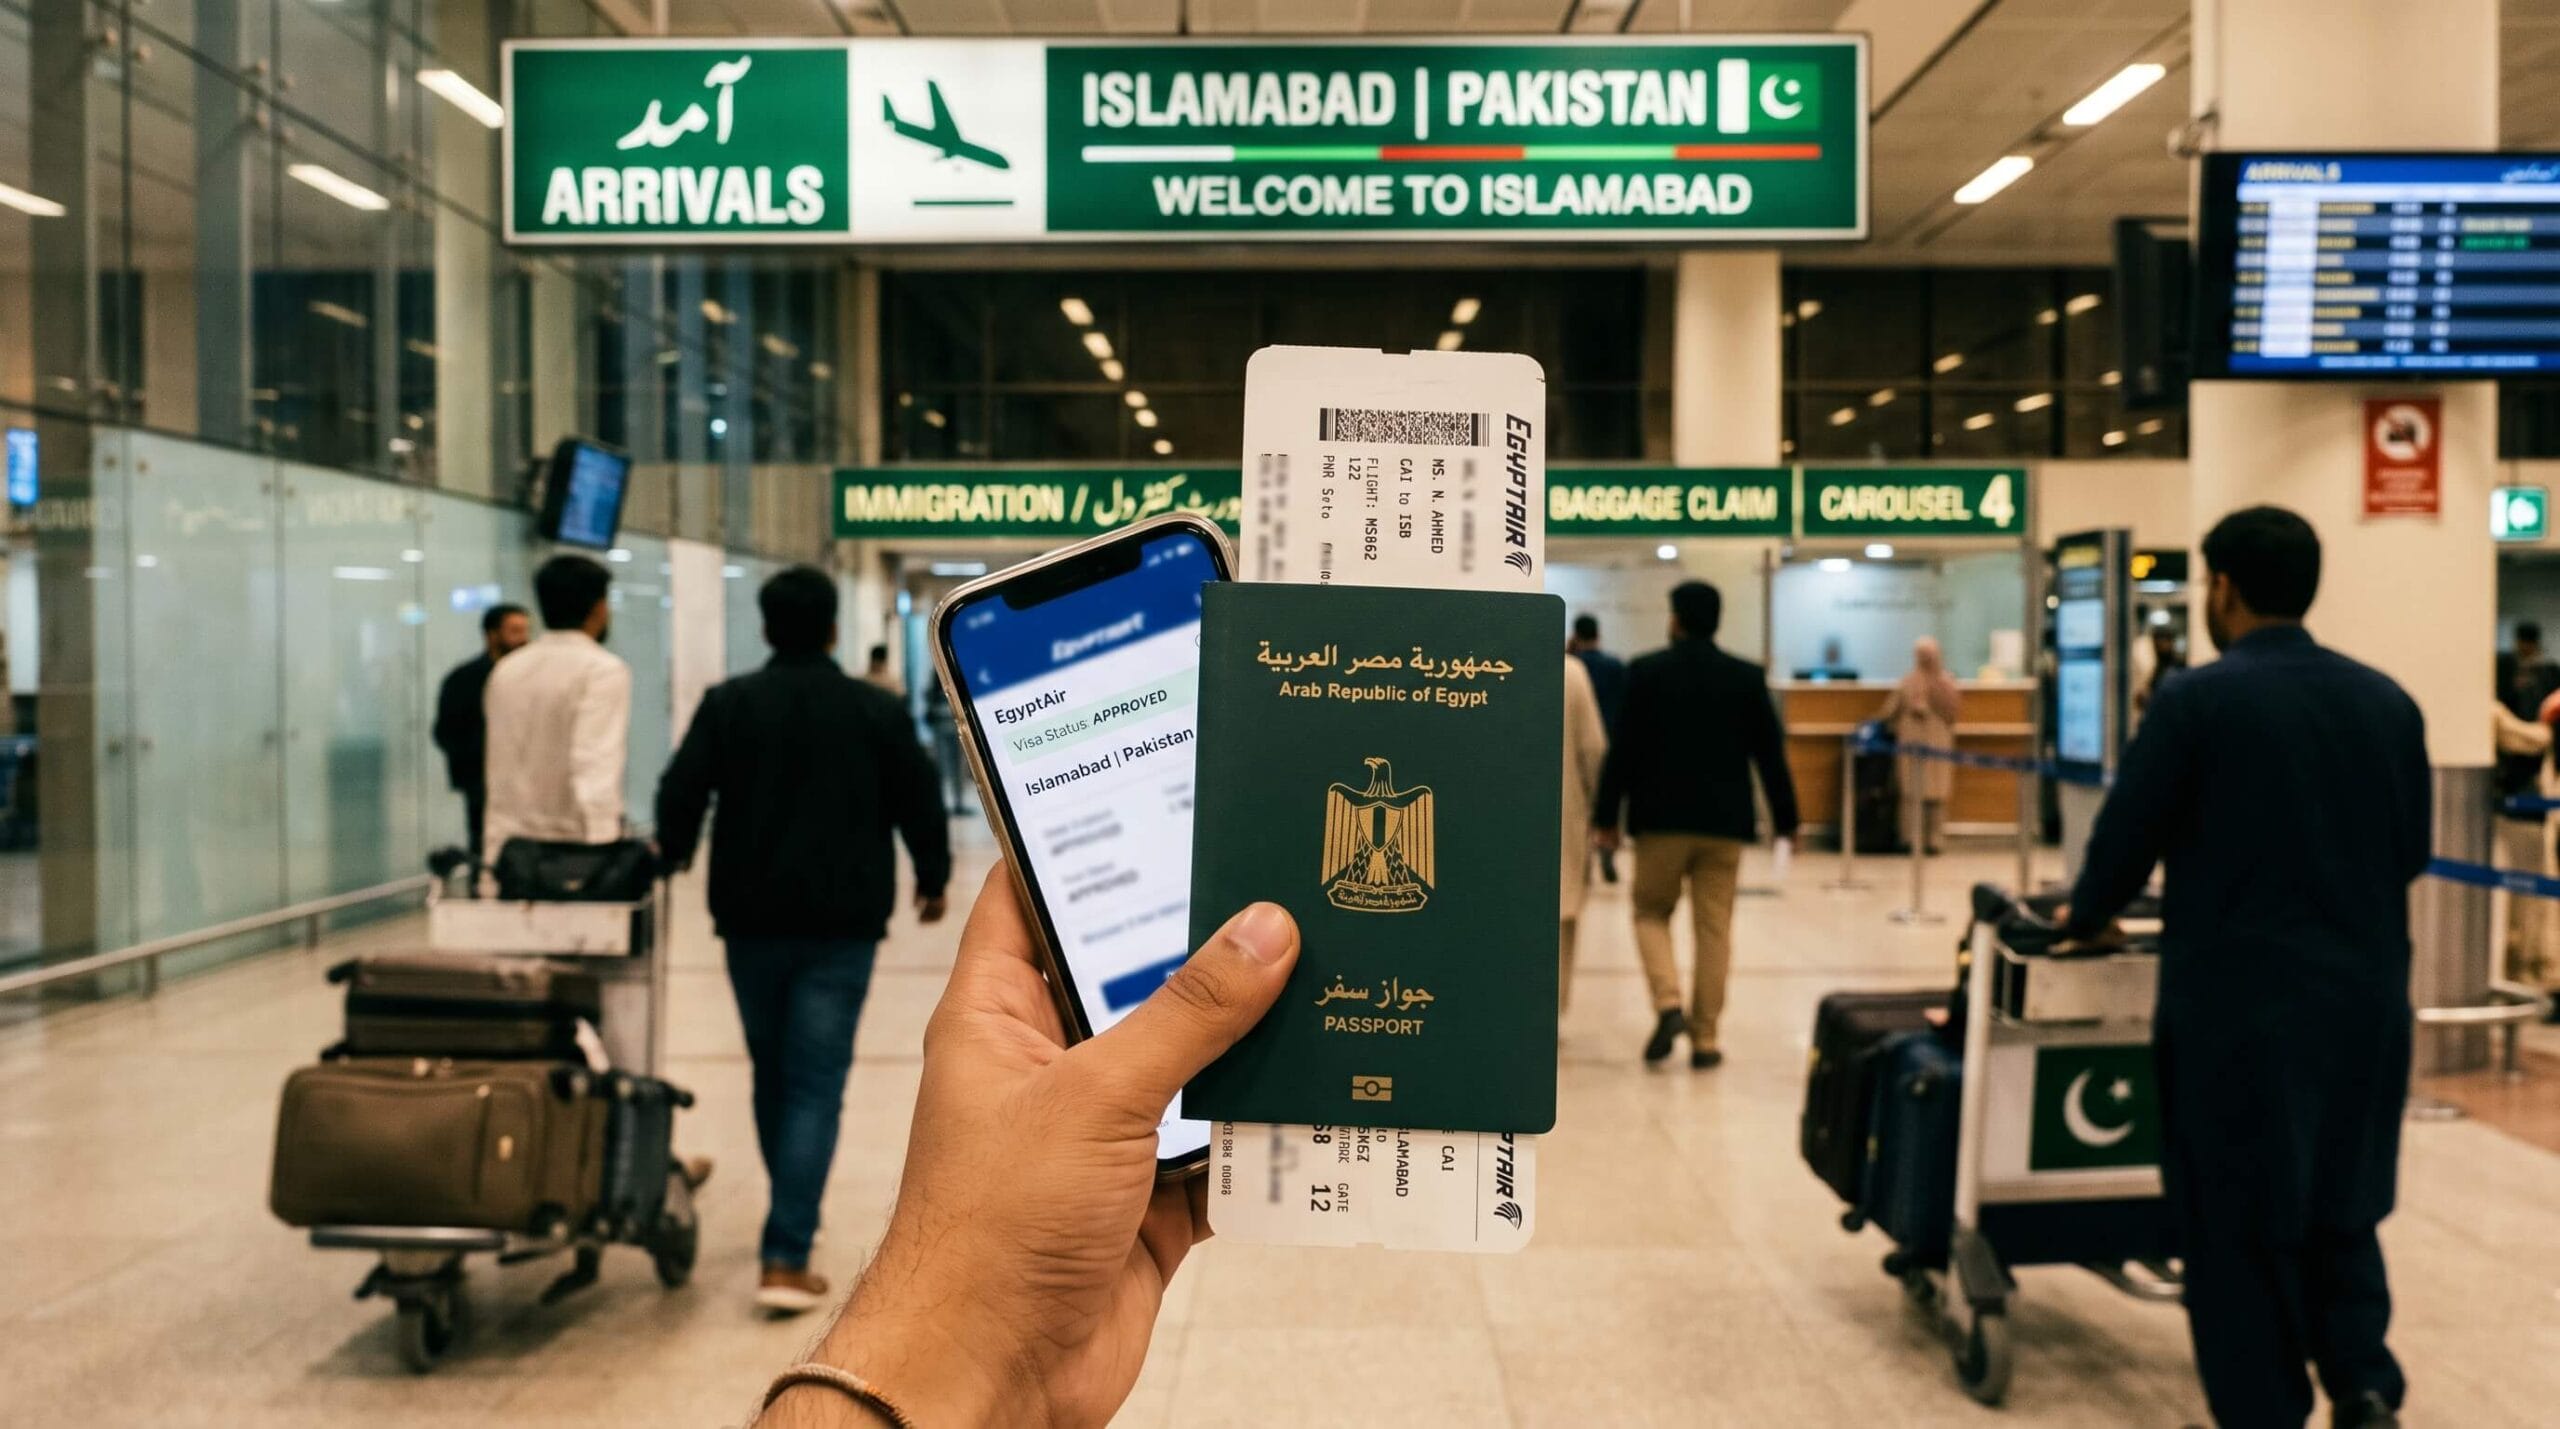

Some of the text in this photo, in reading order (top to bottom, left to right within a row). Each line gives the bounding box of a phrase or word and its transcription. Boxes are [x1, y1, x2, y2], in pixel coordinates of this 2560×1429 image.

[616, 55, 752, 151] آمد
[1083, 70, 1397, 127] ISLAMABAD
[1447, 71, 1707, 127] PAKISTAN
[542, 165, 826, 225] ARRIVALS
[1151, 174, 1753, 217] WELCOME TO ISLAMABAD
[1322, 455, 1336, 479] PNR
[1505, 413, 1532, 548] EGYPTAIR
[844, 483, 1065, 523] IMMIGRATION
[1363, 457, 1379, 561] FLIGHT: MS862
[1398, 458, 1413, 539] CAI to ISB
[1430, 458, 1445, 554] MS. N. AHMED
[1548, 485, 1778, 521] BAGGAGE CLAIM
[1819, 474, 2015, 528] CAROUSEL 4
[1256, 640, 1514, 681] جمهورية مصر العربية
[994, 689, 1067, 724] EgyptAir
[1013, 689, 1168, 752] Visa Status: APPROVED
[1279, 681, 1488, 708] Arab Republic of Egypt
[1025, 754, 1112, 796] Islamabad
[1122, 728, 1195, 761] Pakistan
[1314, 974, 1435, 1011] جواز سفر
[1324, 1015, 1425, 1036] PASSPORT
[1395, 1128, 1410, 1198] LAMABAD
[1496, 1132, 1514, 1199] PTAIR
[1310, 1184, 1332, 1212] 12
[1336, 1182, 1350, 1213] GATE
